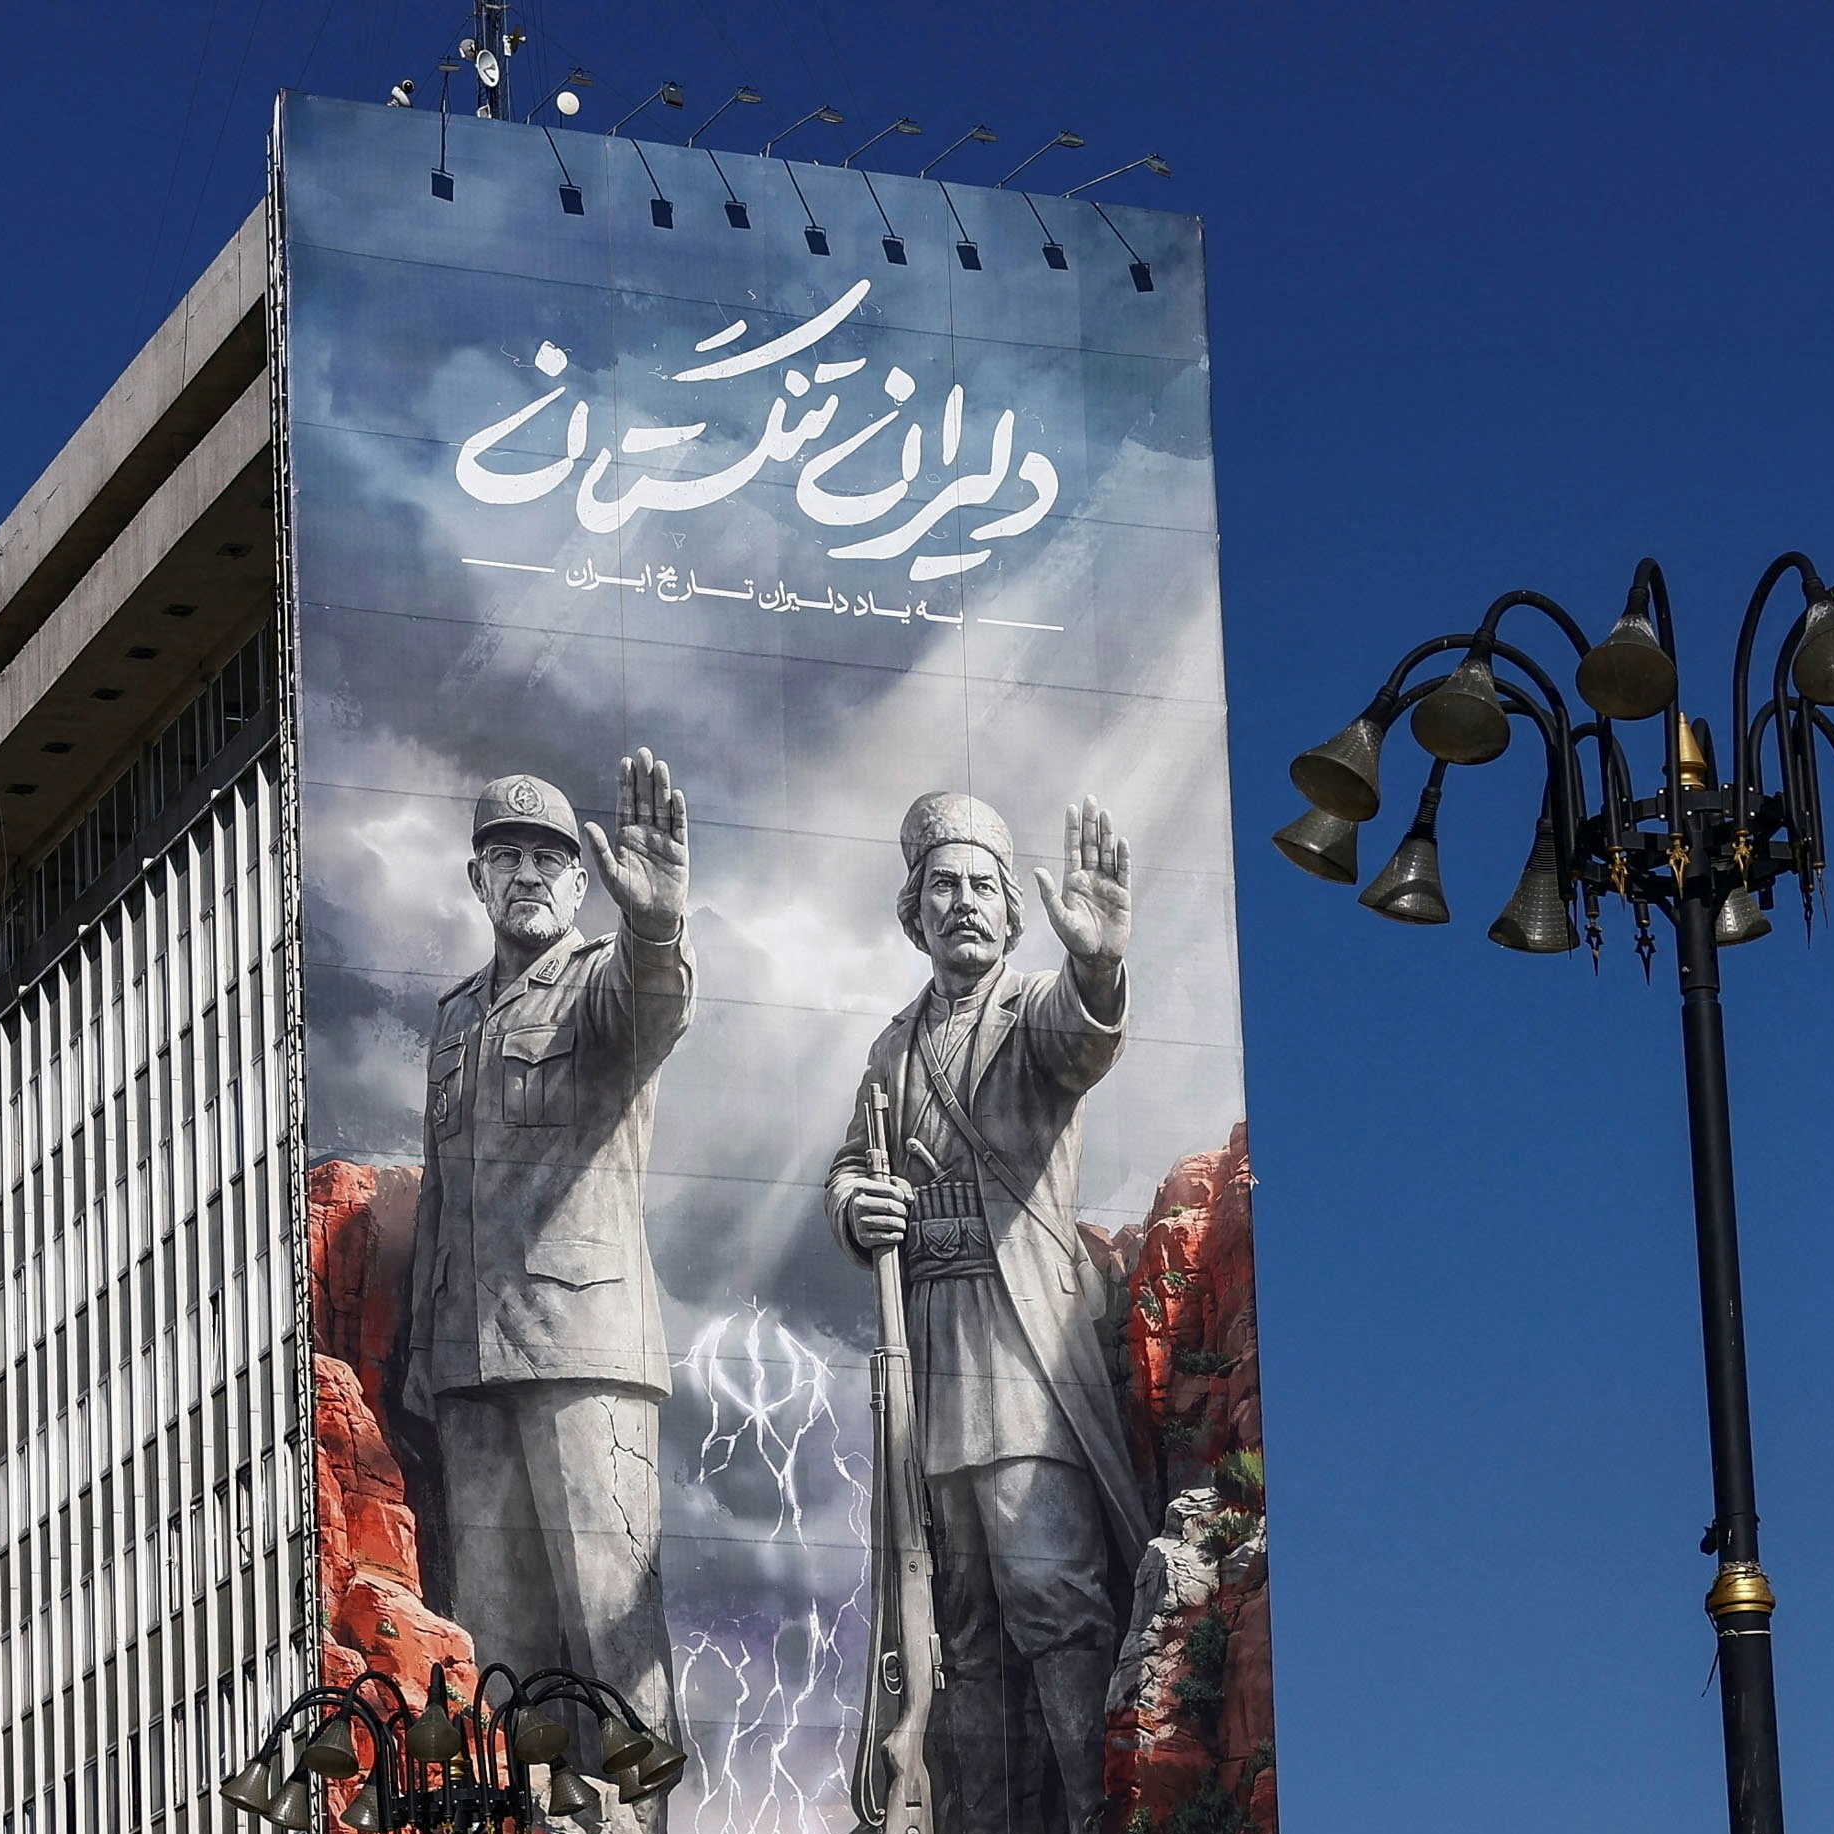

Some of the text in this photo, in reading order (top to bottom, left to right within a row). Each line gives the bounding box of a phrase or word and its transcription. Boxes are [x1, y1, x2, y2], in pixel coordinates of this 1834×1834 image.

[456, 279, 1059, 581] دلیران تنگستان
[566, 558, 964, 630] به یاد دلیران تاریخ ایران
